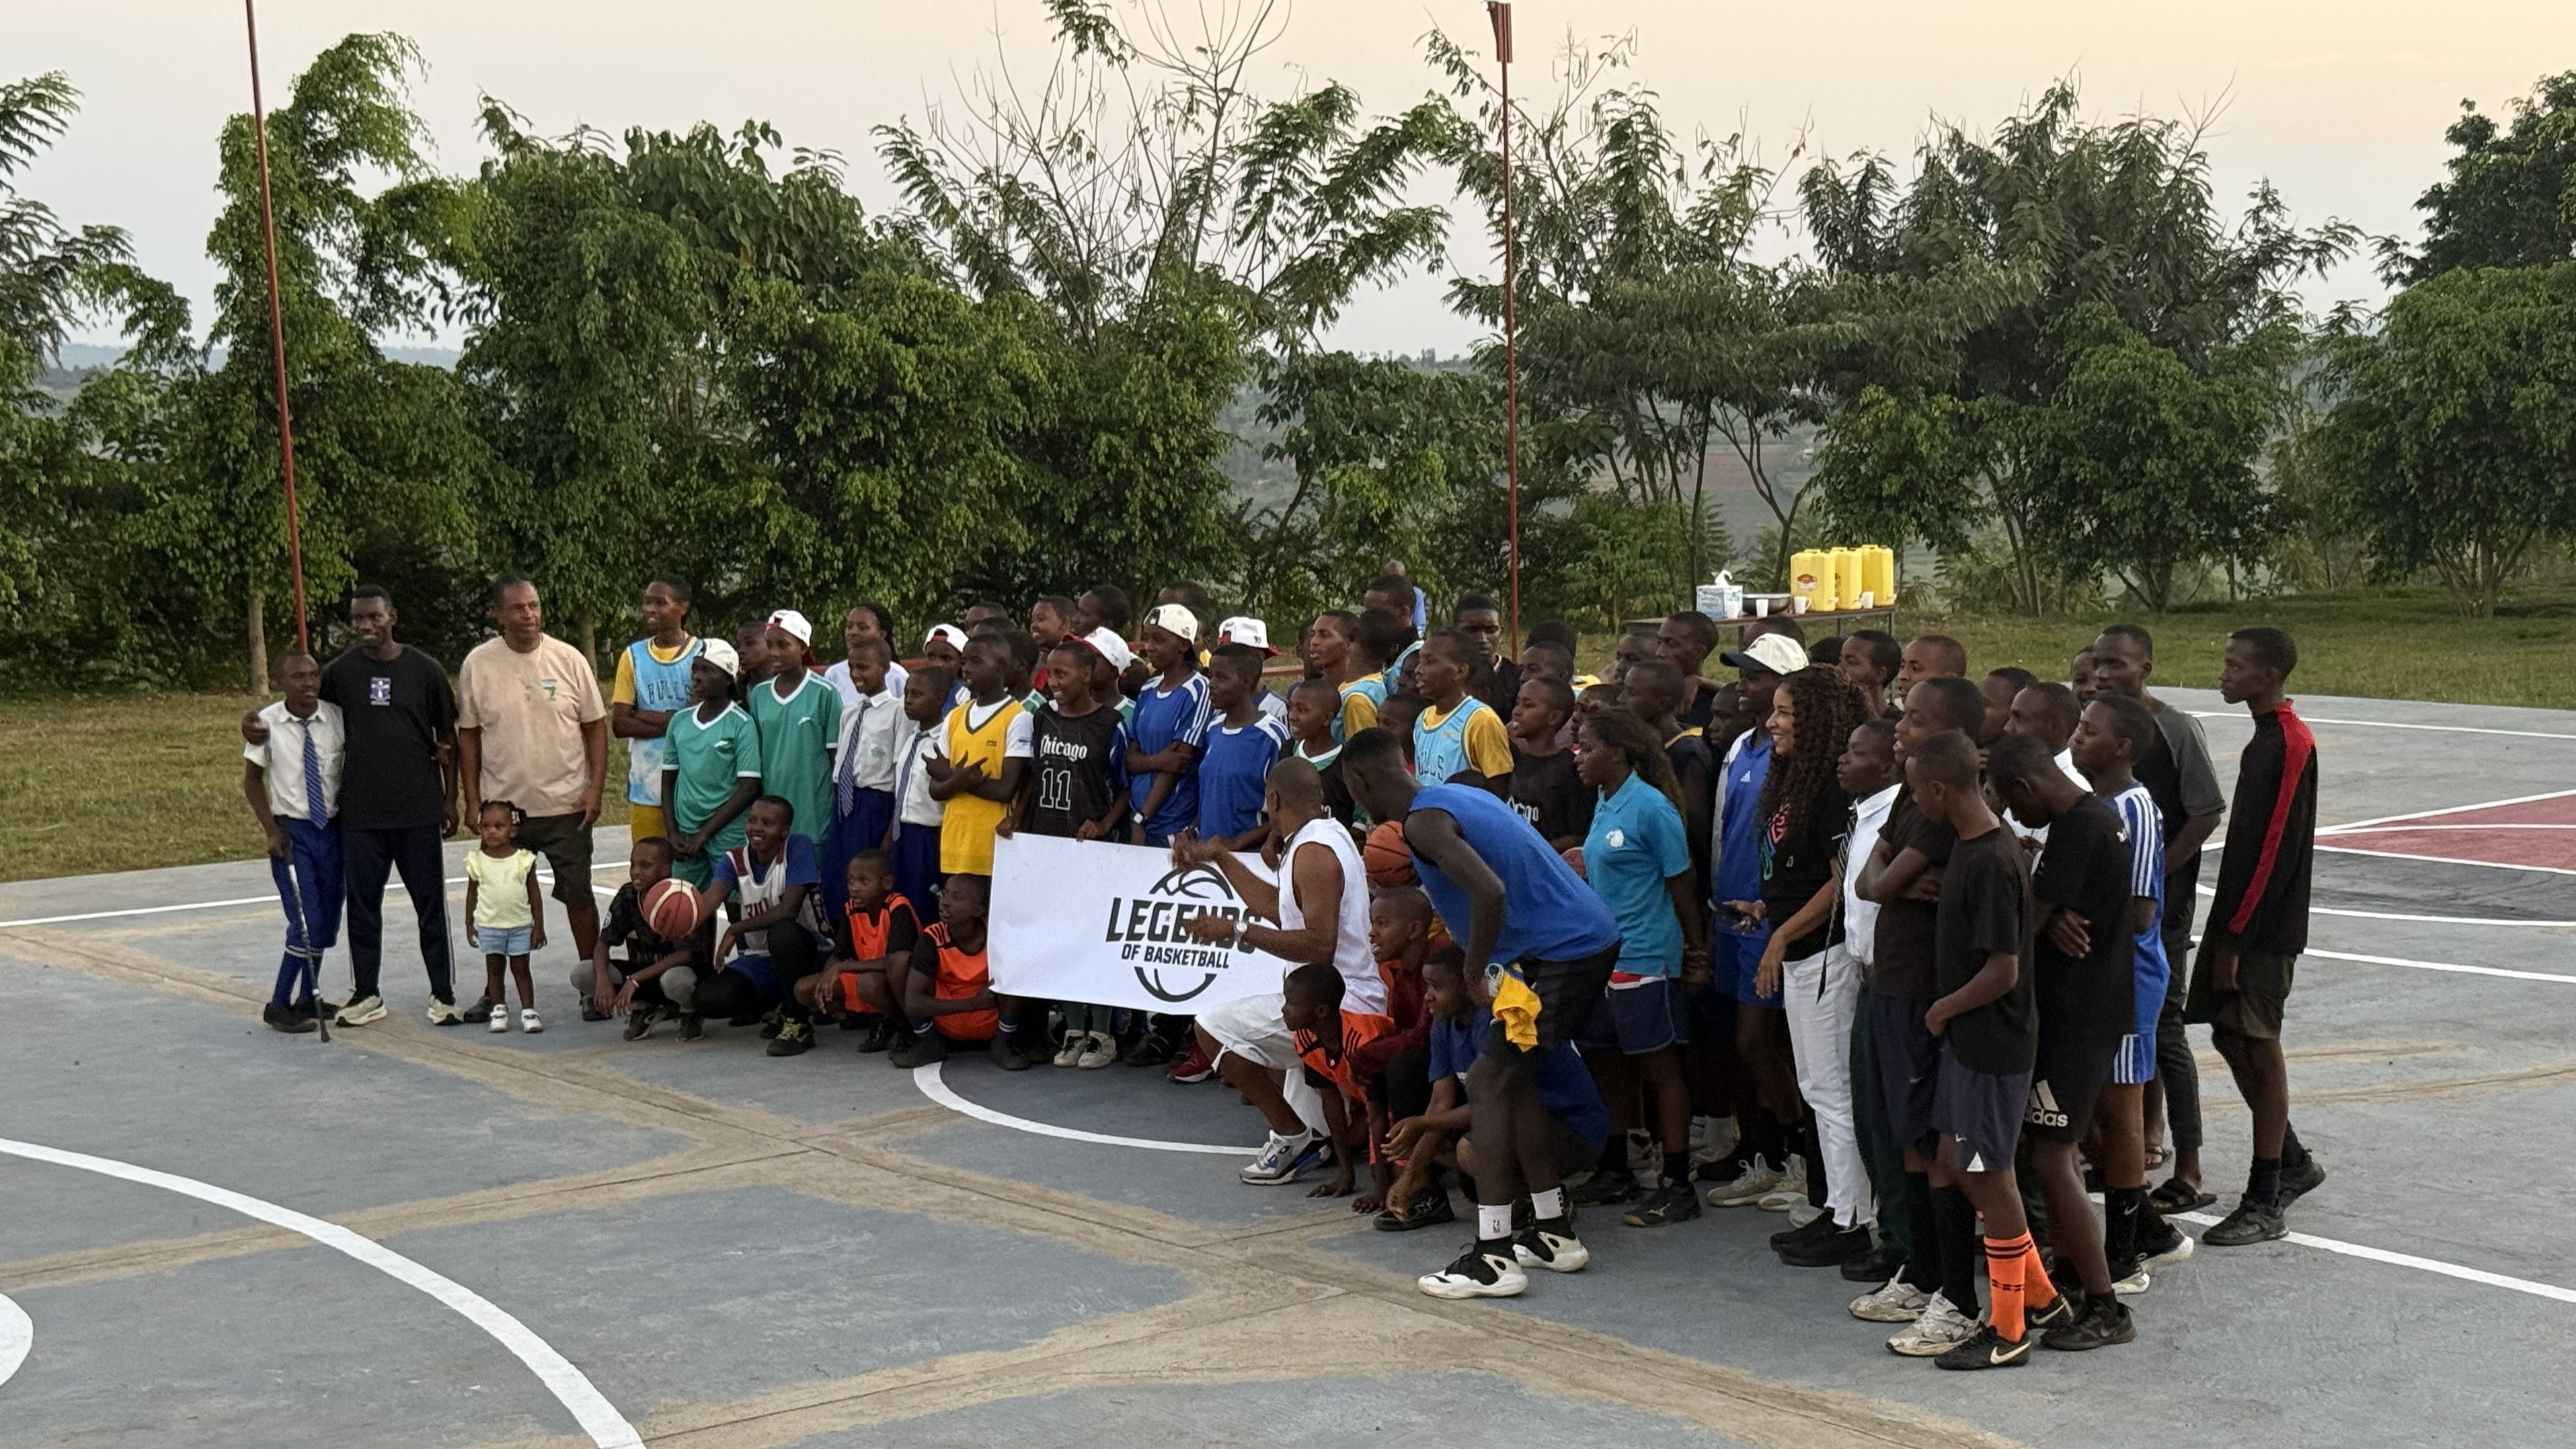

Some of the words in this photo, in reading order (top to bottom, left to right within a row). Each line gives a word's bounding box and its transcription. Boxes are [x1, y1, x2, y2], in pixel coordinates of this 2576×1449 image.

[1040, 734, 1087, 762] Chicago
[1417, 750, 1444, 781] ULLS
[1040, 769, 1070, 810] 11
[1122, 943, 1141, 961] OF
[1144, 945, 1229, 969] BASKETBALL
